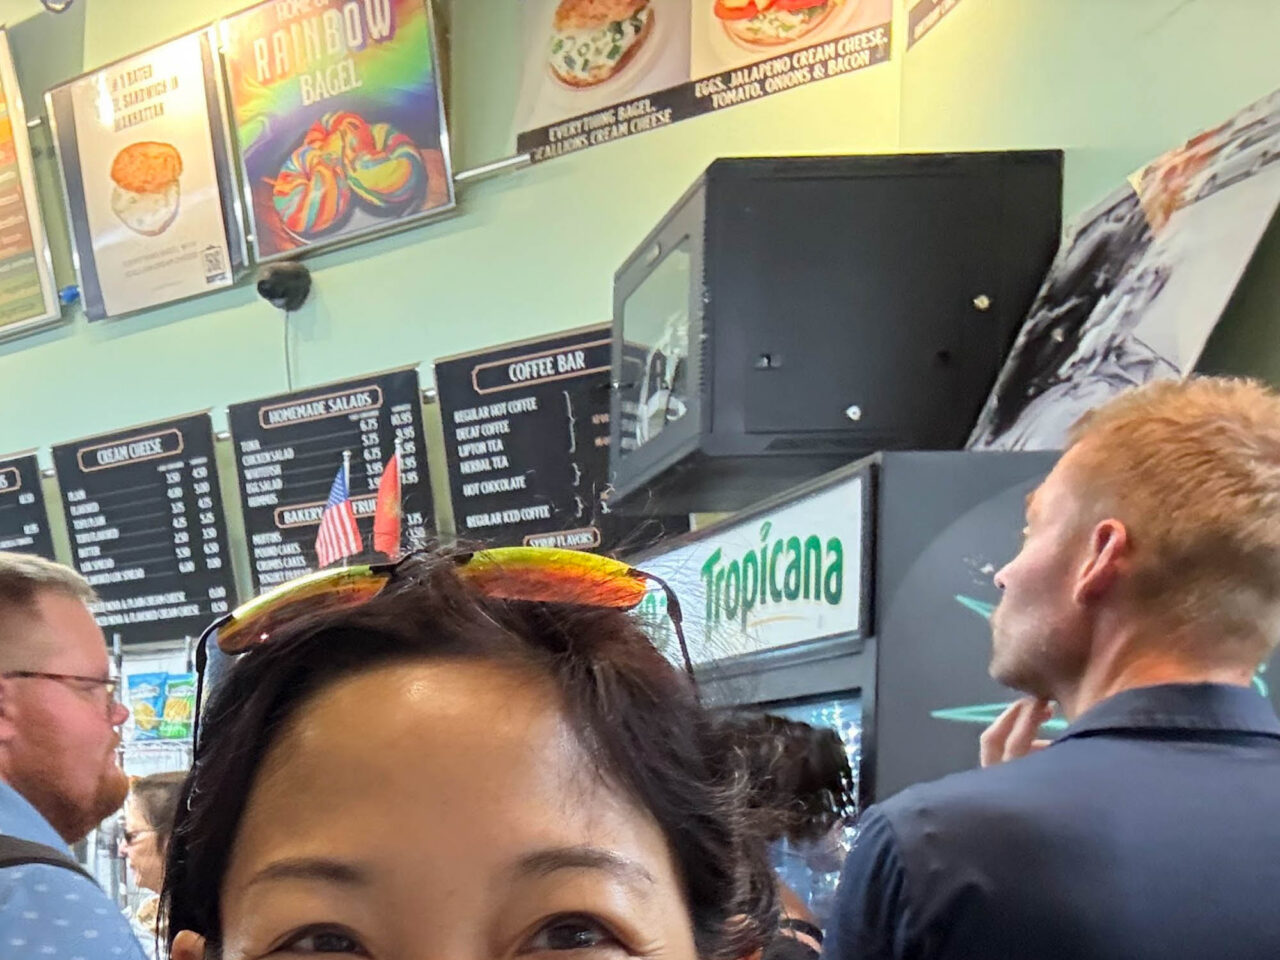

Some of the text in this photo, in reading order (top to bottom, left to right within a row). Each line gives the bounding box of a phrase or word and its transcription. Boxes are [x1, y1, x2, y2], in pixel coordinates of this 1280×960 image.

[253, 0, 391, 82] RAINBOW
[729, 56, 791, 88] JALAPENO
[792, 44, 836, 69] CREAM
[764, 67, 811, 93] ONIONS
[812, 65, 826, 80] &
[827, 49, 870, 75] BACON
[300, 58, 362, 106] BAGEL
[549, 109, 616, 142] EVERYTHING
[590, 121, 628, 144] CREAM
[630, 108, 672, 132] CHEESE
[508, 350, 586, 382] COFFEE BAR
[269, 401, 327, 425] HOMEMADE
[329, 392, 372, 414] SALADS
[453, 396, 538, 424] REGULAR HOT COFFEE
[479, 419, 511, 436] COFFEE
[96, 437, 163, 465] CREAM CHEESE
[240, 438, 261, 453] TUNA
[272, 446, 295, 462] SALAD
[457, 438, 504, 458] LIPTON TEA
[460, 455, 509, 475] HERBAL TEA
[262, 477, 283, 493] SALAD
[462, 474, 527, 498] HOT CHOCOLATE
[283, 498, 377, 525] BAKERY FRUI
[466, 511, 503, 529] REGULAR
[520, 504, 550, 521] COFFEE
[279, 541, 301, 556] CAKES
[557, 532, 594, 548] FLAVORS
[282, 554, 306, 569] CAKES
[700, 521, 844, 640] Tropicana
